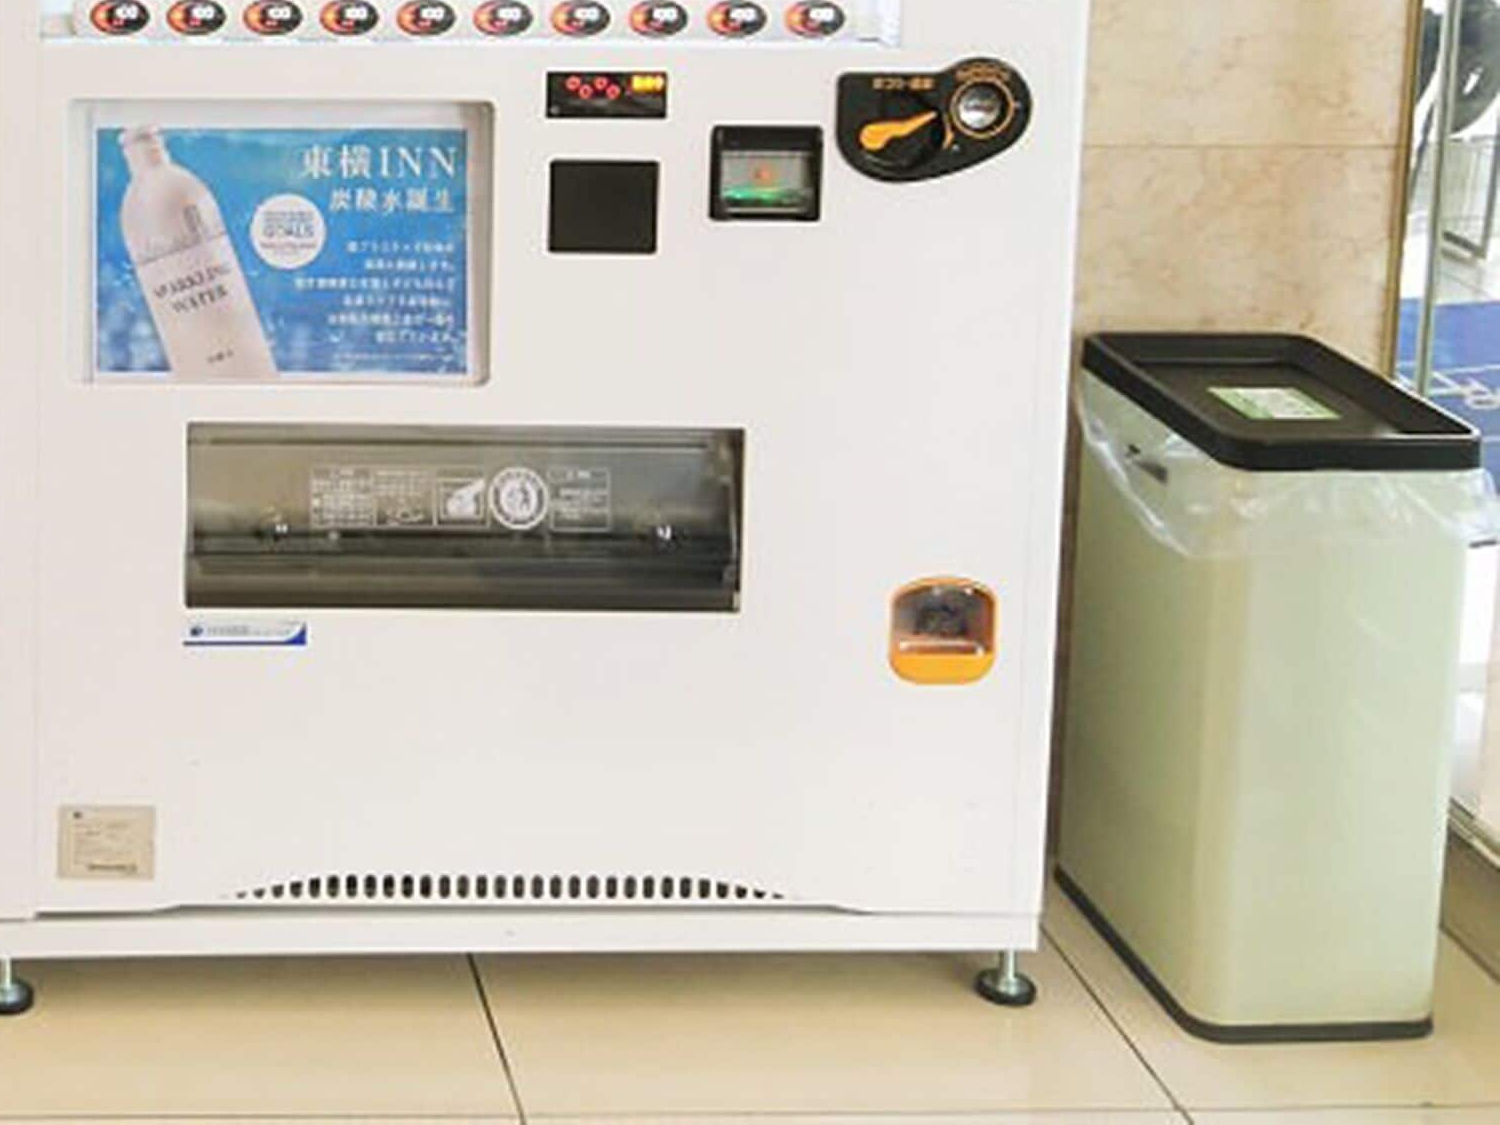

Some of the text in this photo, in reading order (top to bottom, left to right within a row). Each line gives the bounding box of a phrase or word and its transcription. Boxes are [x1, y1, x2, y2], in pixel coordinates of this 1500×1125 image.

[301, 144, 457, 179] 東横INN
[329, 187, 453, 214] 炭酸水誕生
